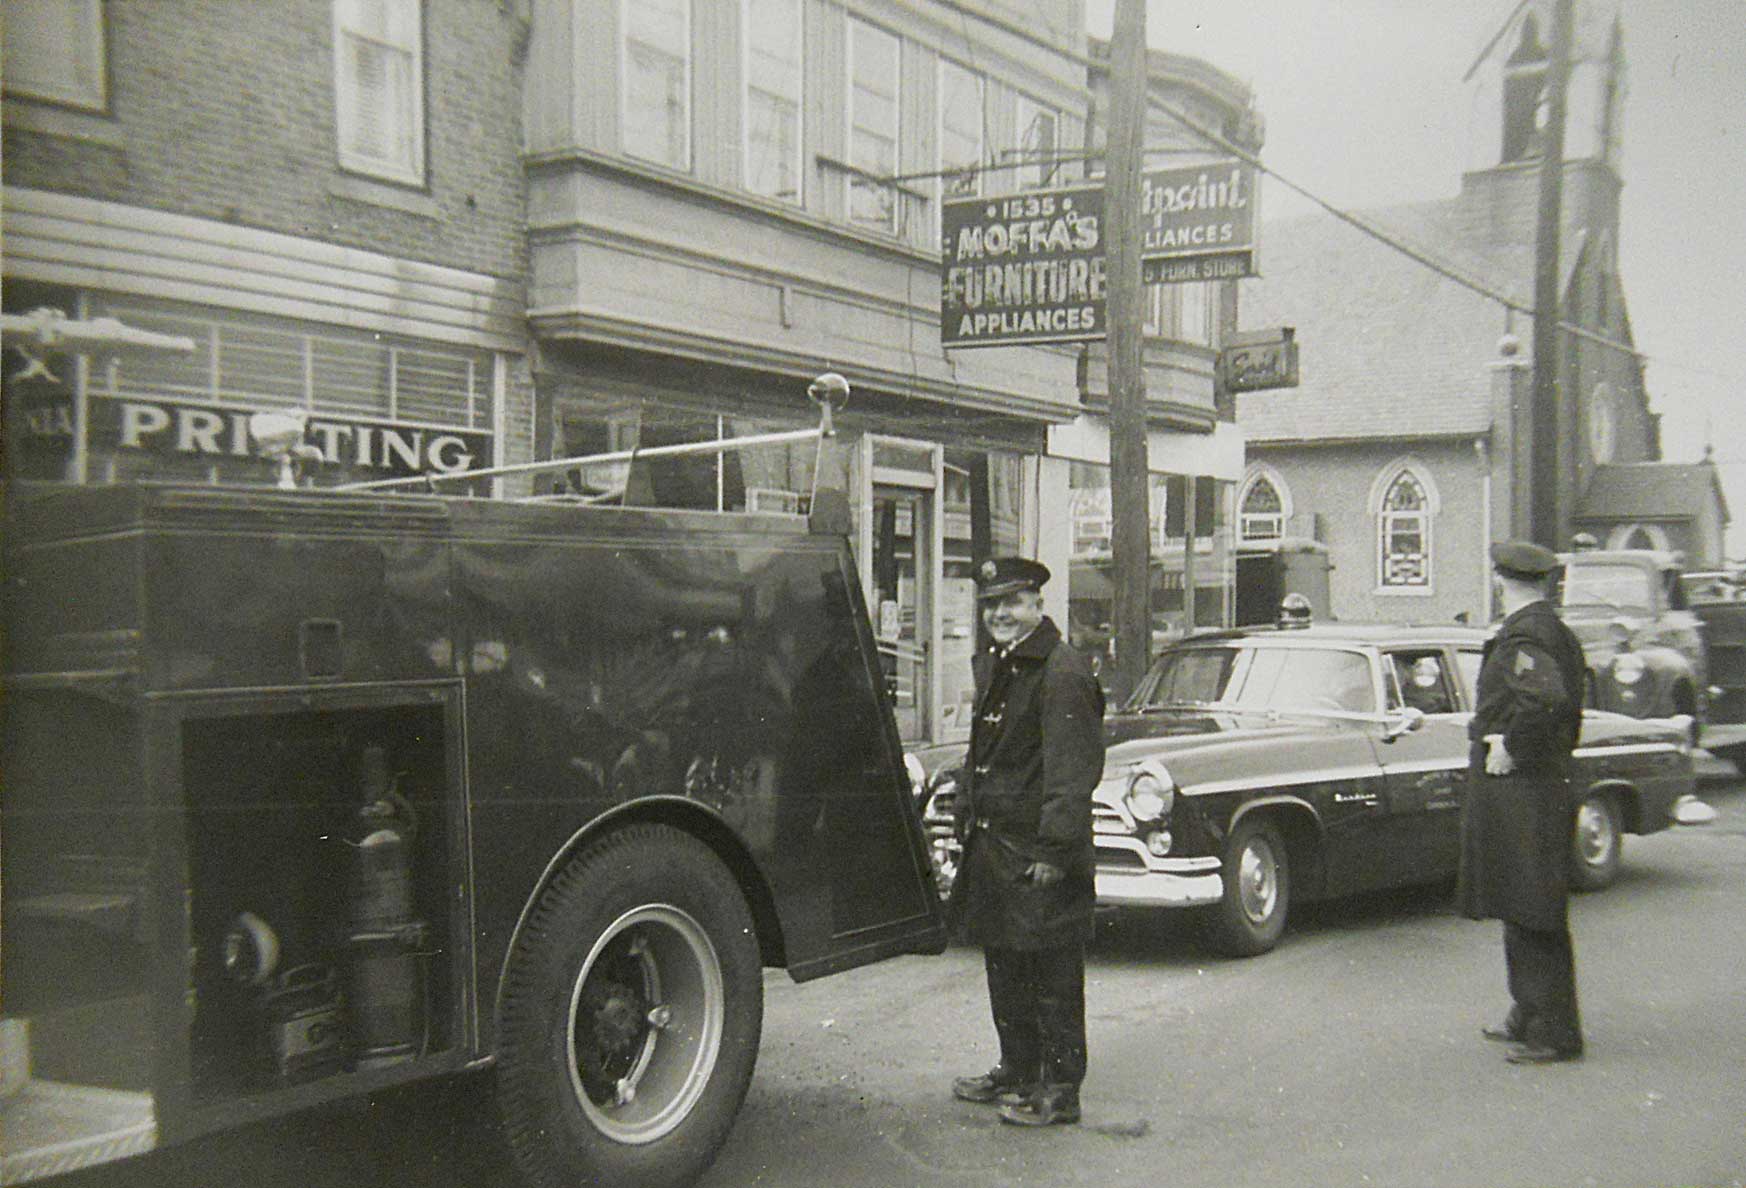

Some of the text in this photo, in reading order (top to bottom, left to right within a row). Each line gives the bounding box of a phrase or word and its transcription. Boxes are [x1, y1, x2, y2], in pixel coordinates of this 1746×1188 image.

[1144, 223, 1233, 248] LIANCES
[949, 257, 1107, 308] FURNITURE
[959, 306, 1096, 337] APPLIANCES
[120, 403, 475, 473] PRITING
